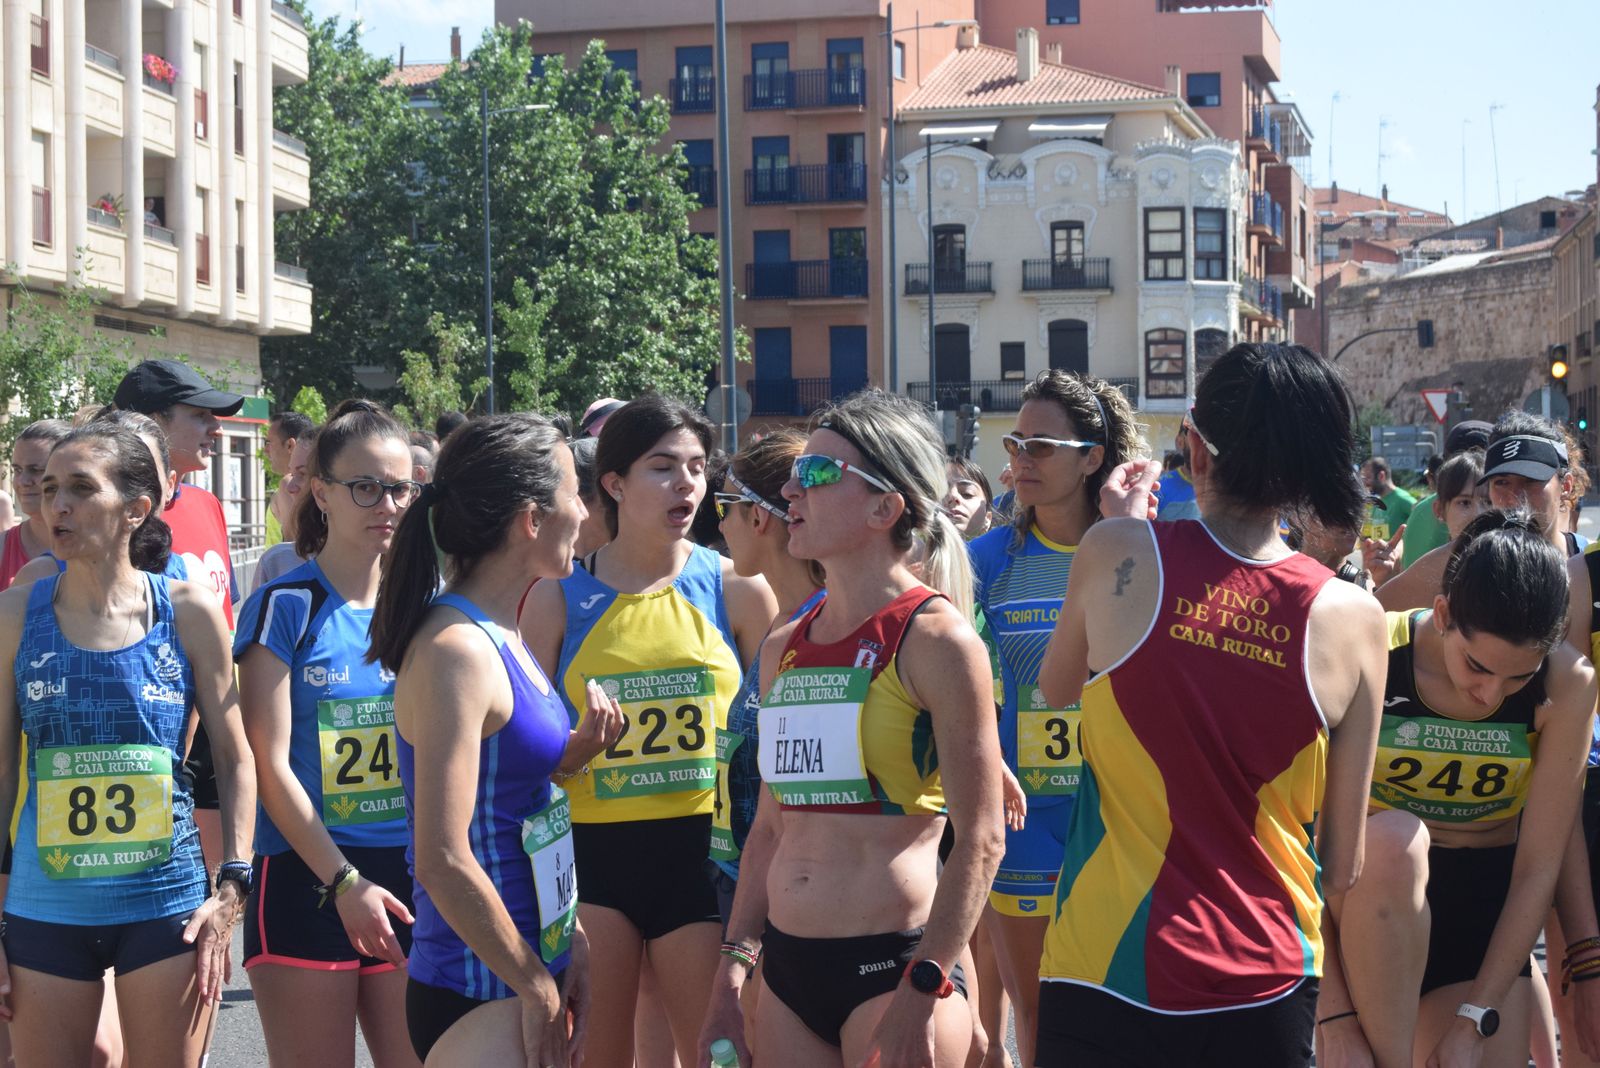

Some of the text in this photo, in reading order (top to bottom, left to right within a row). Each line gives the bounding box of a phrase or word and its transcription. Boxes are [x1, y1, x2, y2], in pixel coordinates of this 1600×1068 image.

[1204, 582, 1270, 616] VINO
[1174, 596, 1291, 644] DE TORO
[1169, 623, 1287, 669] CAJA RURAL
[623, 672, 698, 689] FUNDACION
[784, 673, 851, 690] FUNDACION
[624, 683, 699, 700] CAJA RURAL
[783, 686, 848, 702] CAJA RURAL
[357, 712, 383, 725] CAJA
[1423, 724, 1511, 742] FUNDACION
[1423, 737, 1512, 755] CAJA RURAL
[74, 750, 153, 763] FUNDACION
[334, 732, 401, 786] 24
[774, 738, 824, 774] ELENA
[75, 761, 153, 776] CAJA RURAL
[631, 767, 714, 786] CAJA RURAL
[1385, 756, 1510, 798] 248
[1050, 774, 1080, 786] CAJA
[359, 799, 389, 814] CAJA
[783, 790, 864, 805] CAJA RURAL
[67, 783, 137, 837] 83
[1406, 800, 1505, 818] CAJA RURAL
[72, 847, 163, 868] CAJA RURAL
[555, 852, 561, 871] 8
[858, 959, 897, 976] Joma
